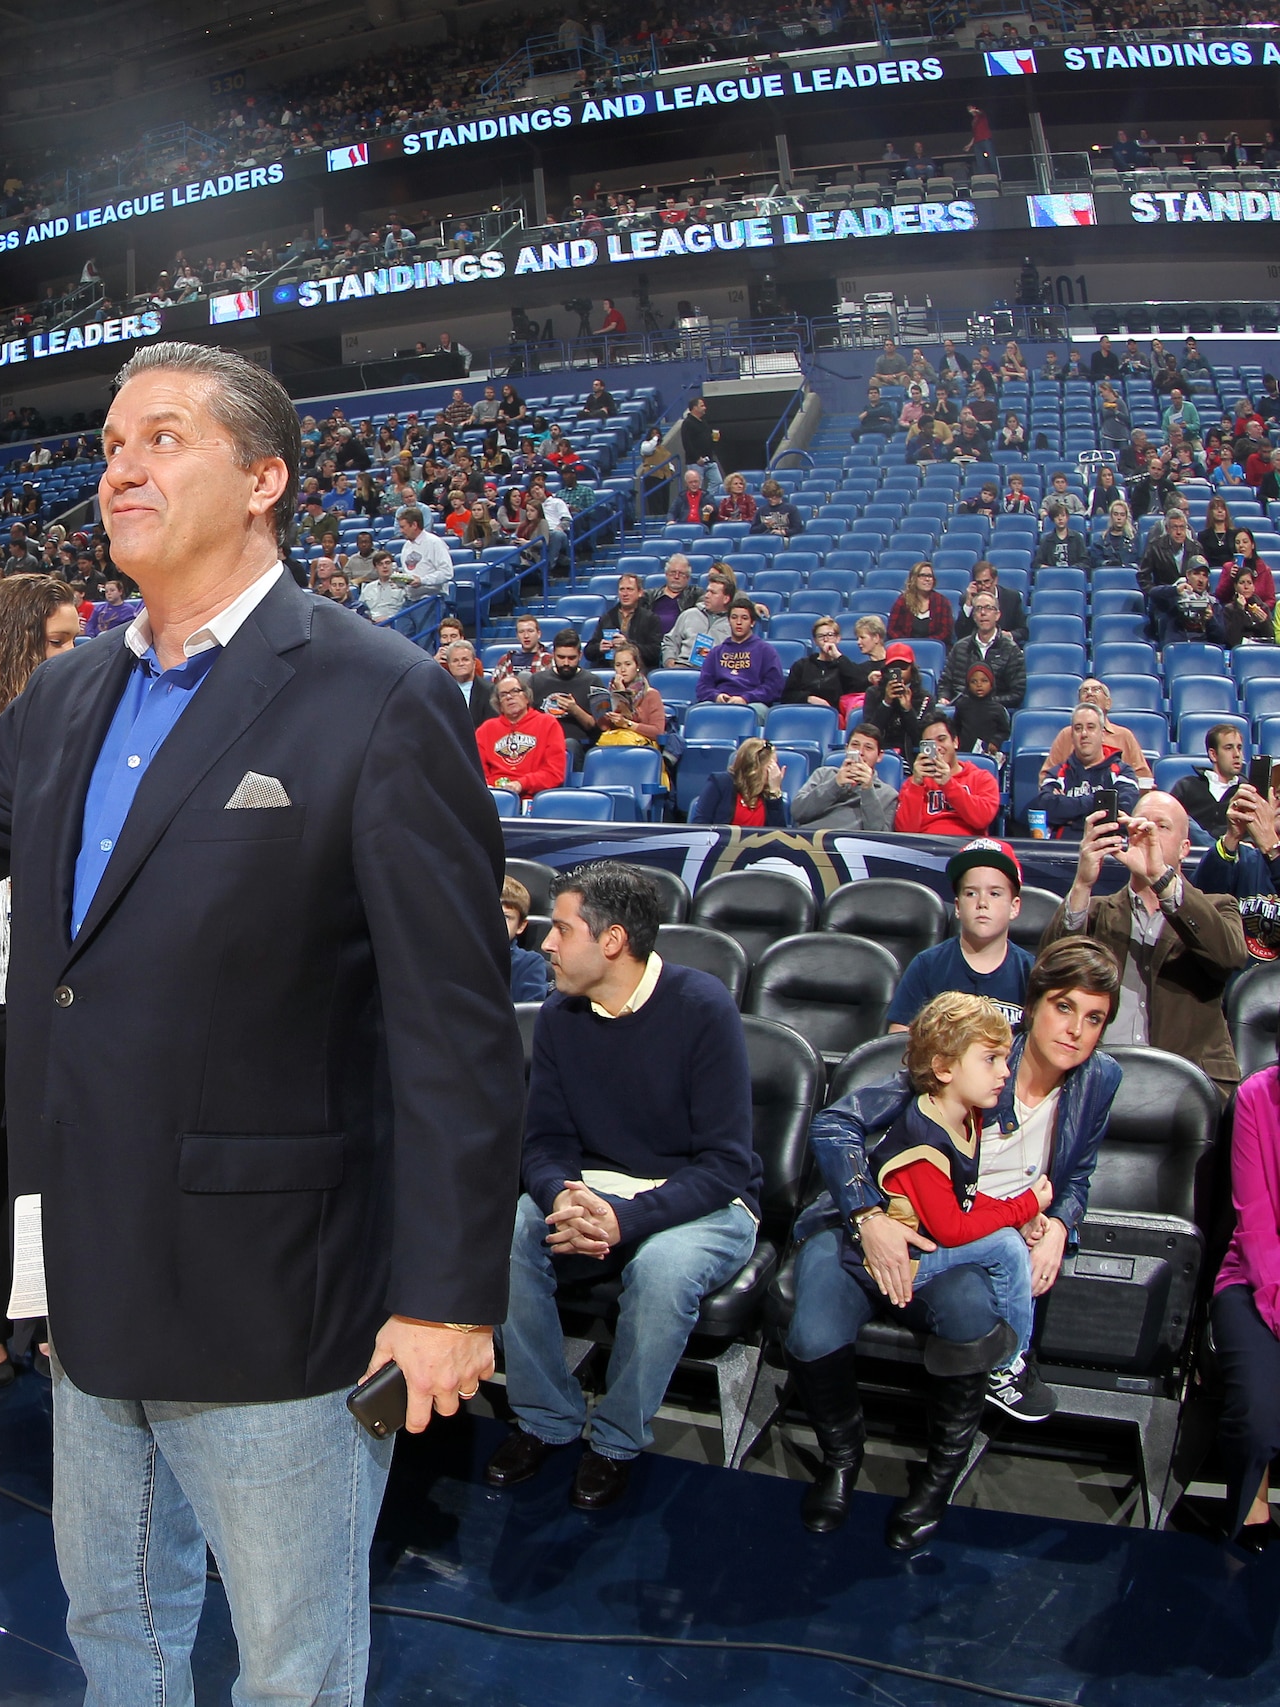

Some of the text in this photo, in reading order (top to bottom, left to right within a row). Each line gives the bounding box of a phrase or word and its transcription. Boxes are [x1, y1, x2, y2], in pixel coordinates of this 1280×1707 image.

[1064, 42, 1252, 71] STANDINGS
[403, 57, 944, 155] STANDINGS AND LEAGUE LEADERS
[25, 217, 69, 244] AND
[76, 192, 165, 232] LEAGUE
[172, 163, 284, 207] LEADERS
[298, 200, 979, 308] STANDINGS AND LEAGUE LEADERS
[728, 290, 744, 303] 124
[33, 311, 162, 358] LEADERS
[719, 659, 750, 669] TIGERS
[722, 651, 750, 660] GEAUX
